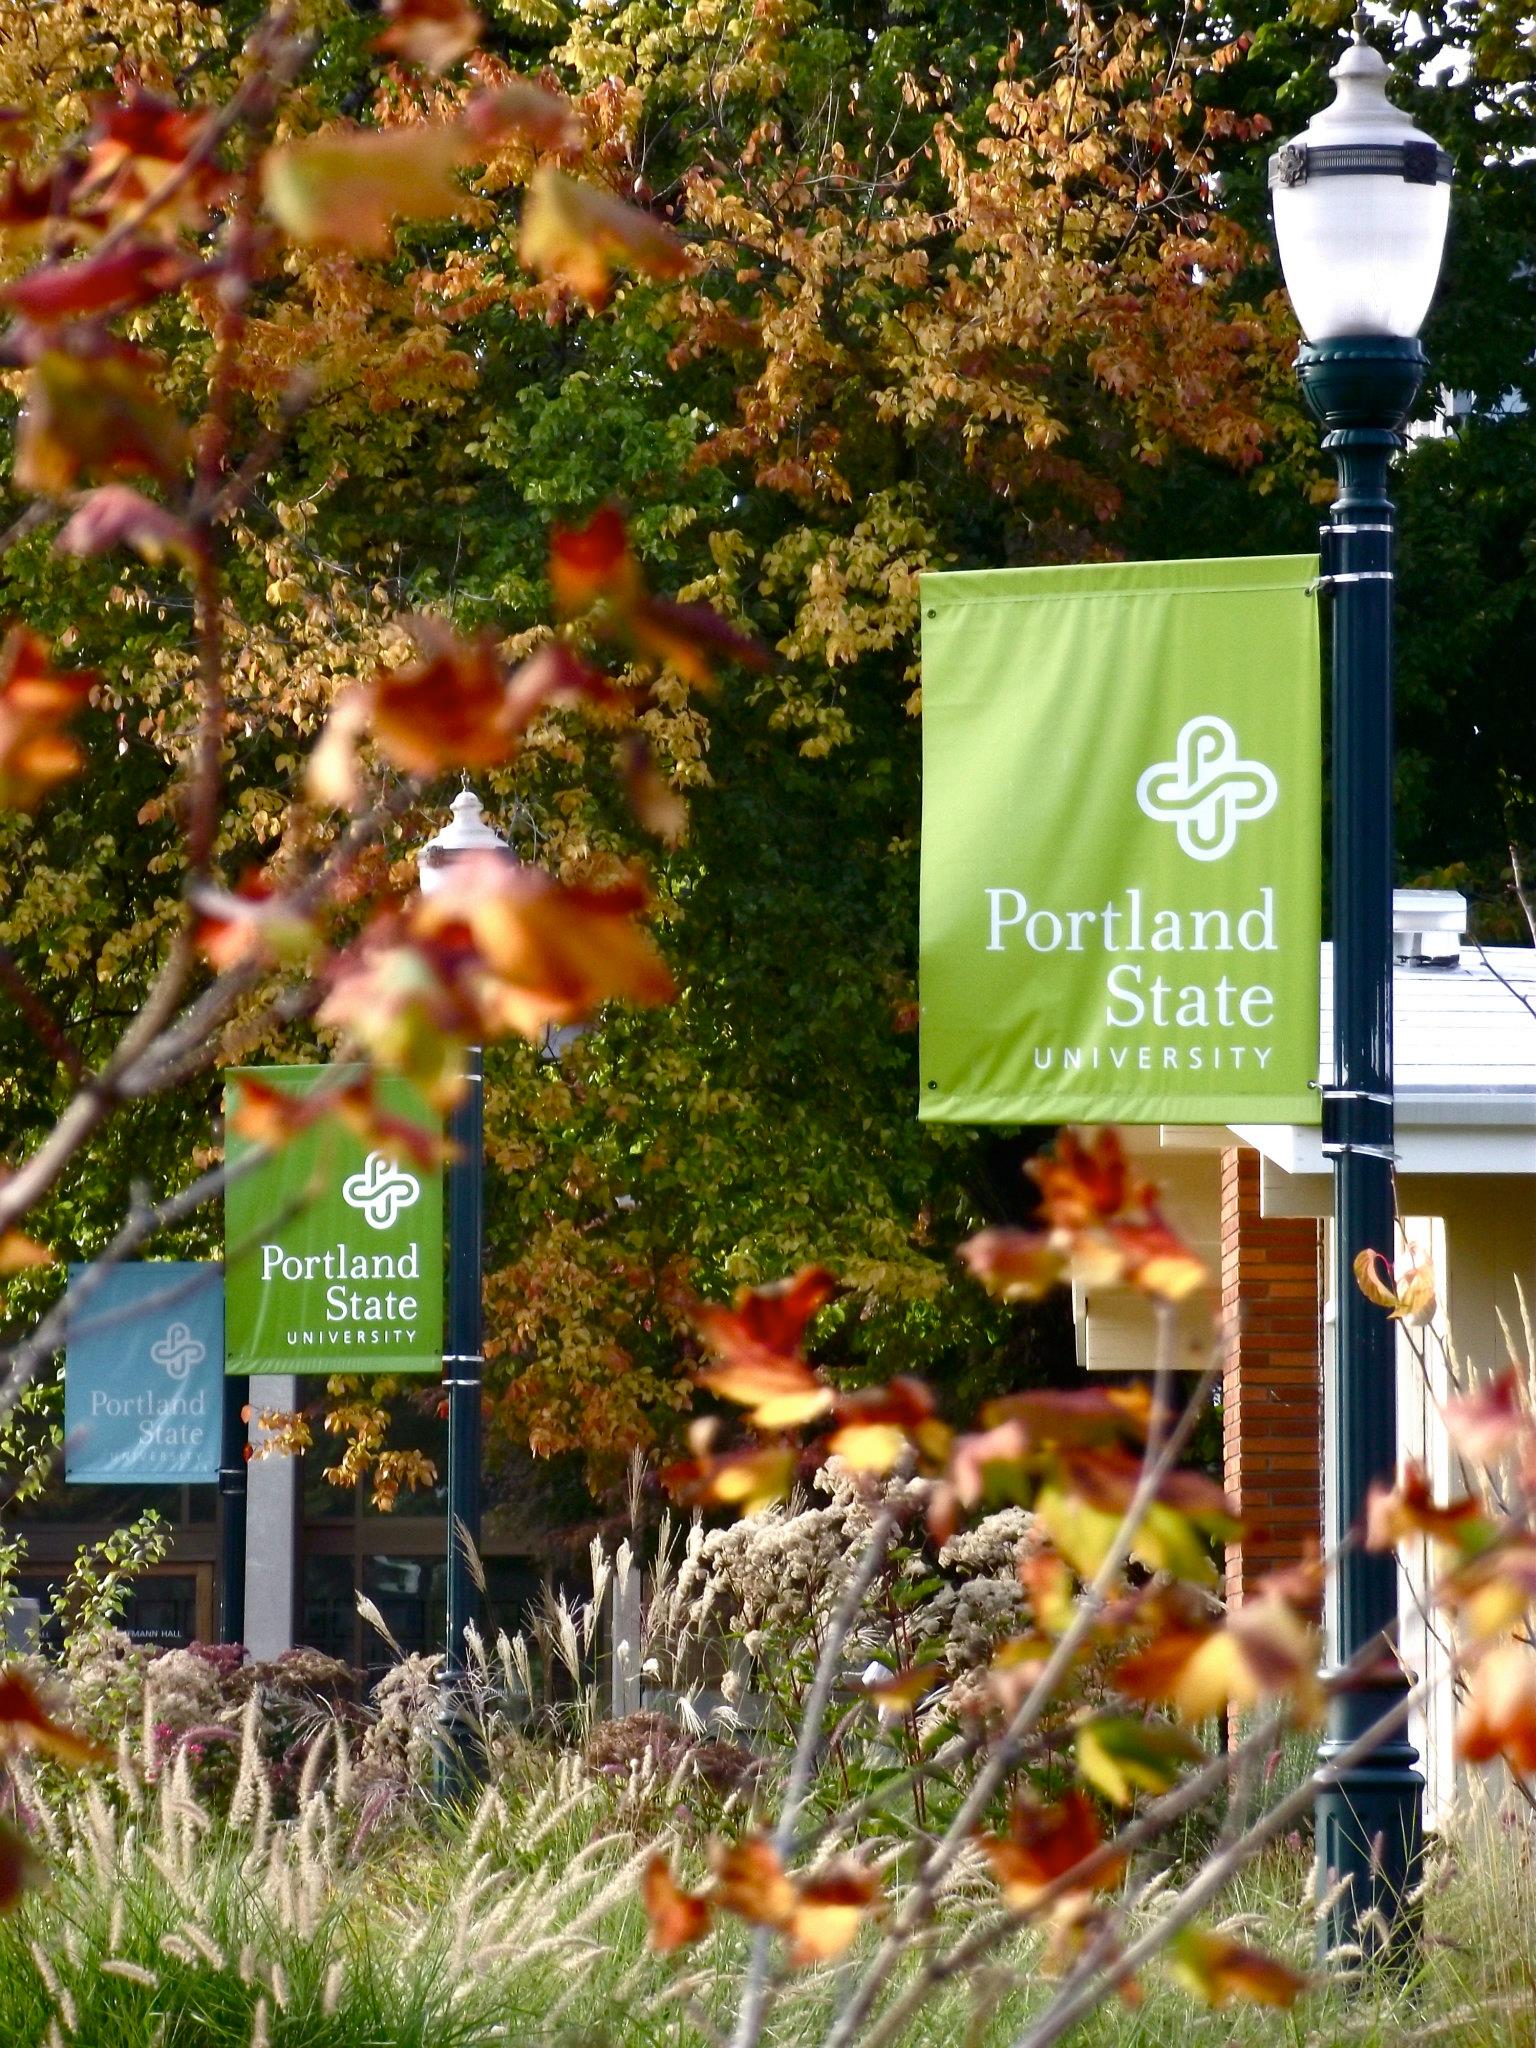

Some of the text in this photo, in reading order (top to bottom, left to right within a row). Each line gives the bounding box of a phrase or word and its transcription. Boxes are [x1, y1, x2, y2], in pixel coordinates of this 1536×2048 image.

[984, 887, 1278, 953] Portland
[1105, 963, 1275, 1028] State
[1034, 1046, 1273, 1070] UNIVERSITY
[261, 1242, 420, 1281] Portland
[326, 1285, 418, 1321] State
[287, 1330, 416, 1345] UNIVERSITY
[91, 1390, 206, 1417] Portland
[138, 1420, 203, 1445] State
[161, 1629, 183, 1638] HALL
